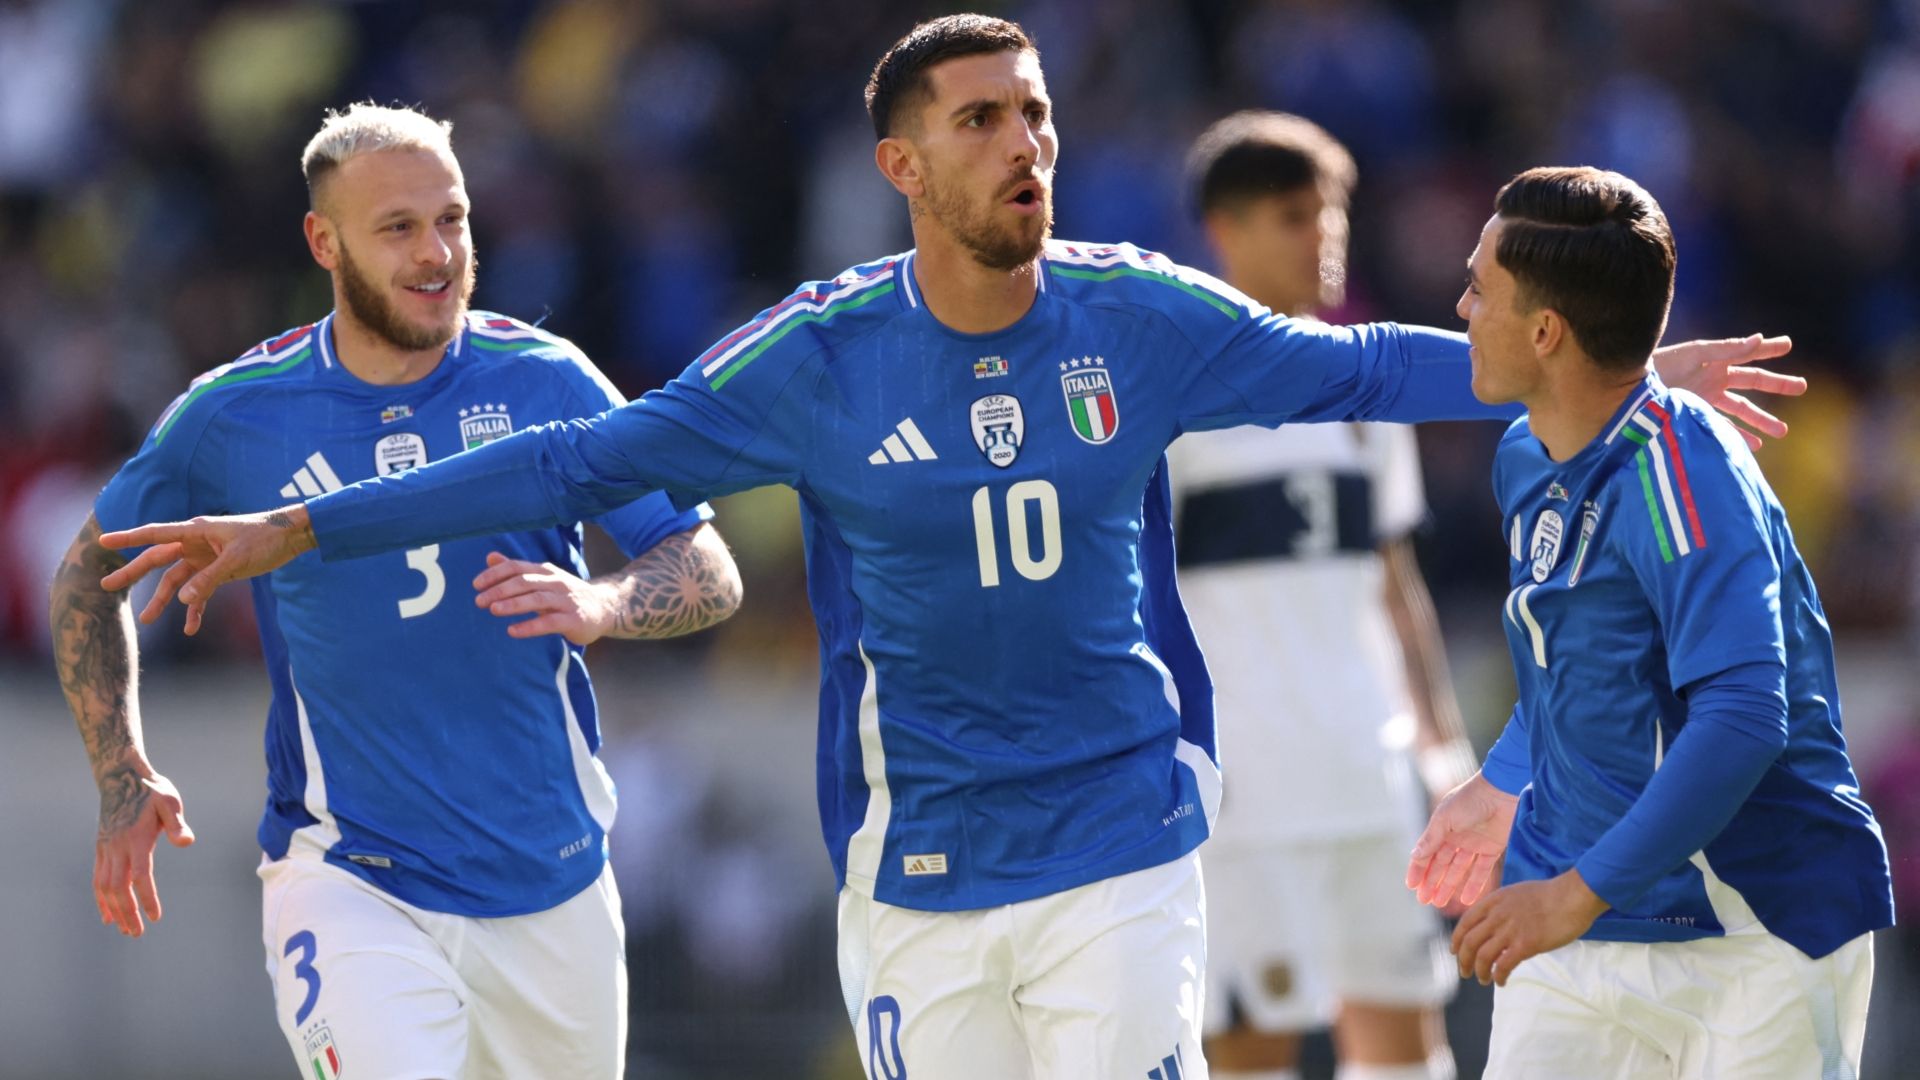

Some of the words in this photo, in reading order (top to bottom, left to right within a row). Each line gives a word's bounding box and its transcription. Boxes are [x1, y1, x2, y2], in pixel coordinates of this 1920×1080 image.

[1065, 374, 1107, 393] ITALIA
[977, 406, 1014, 416] EUROPEAN
[979, 412, 1015, 422] CHAMPIONS
[464, 419, 507, 437] ITALIA
[993, 451, 1012, 460] 2020
[972, 479, 1062, 587] 10
[398, 543, 446, 619] 3
[284, 929, 322, 1028] 3
